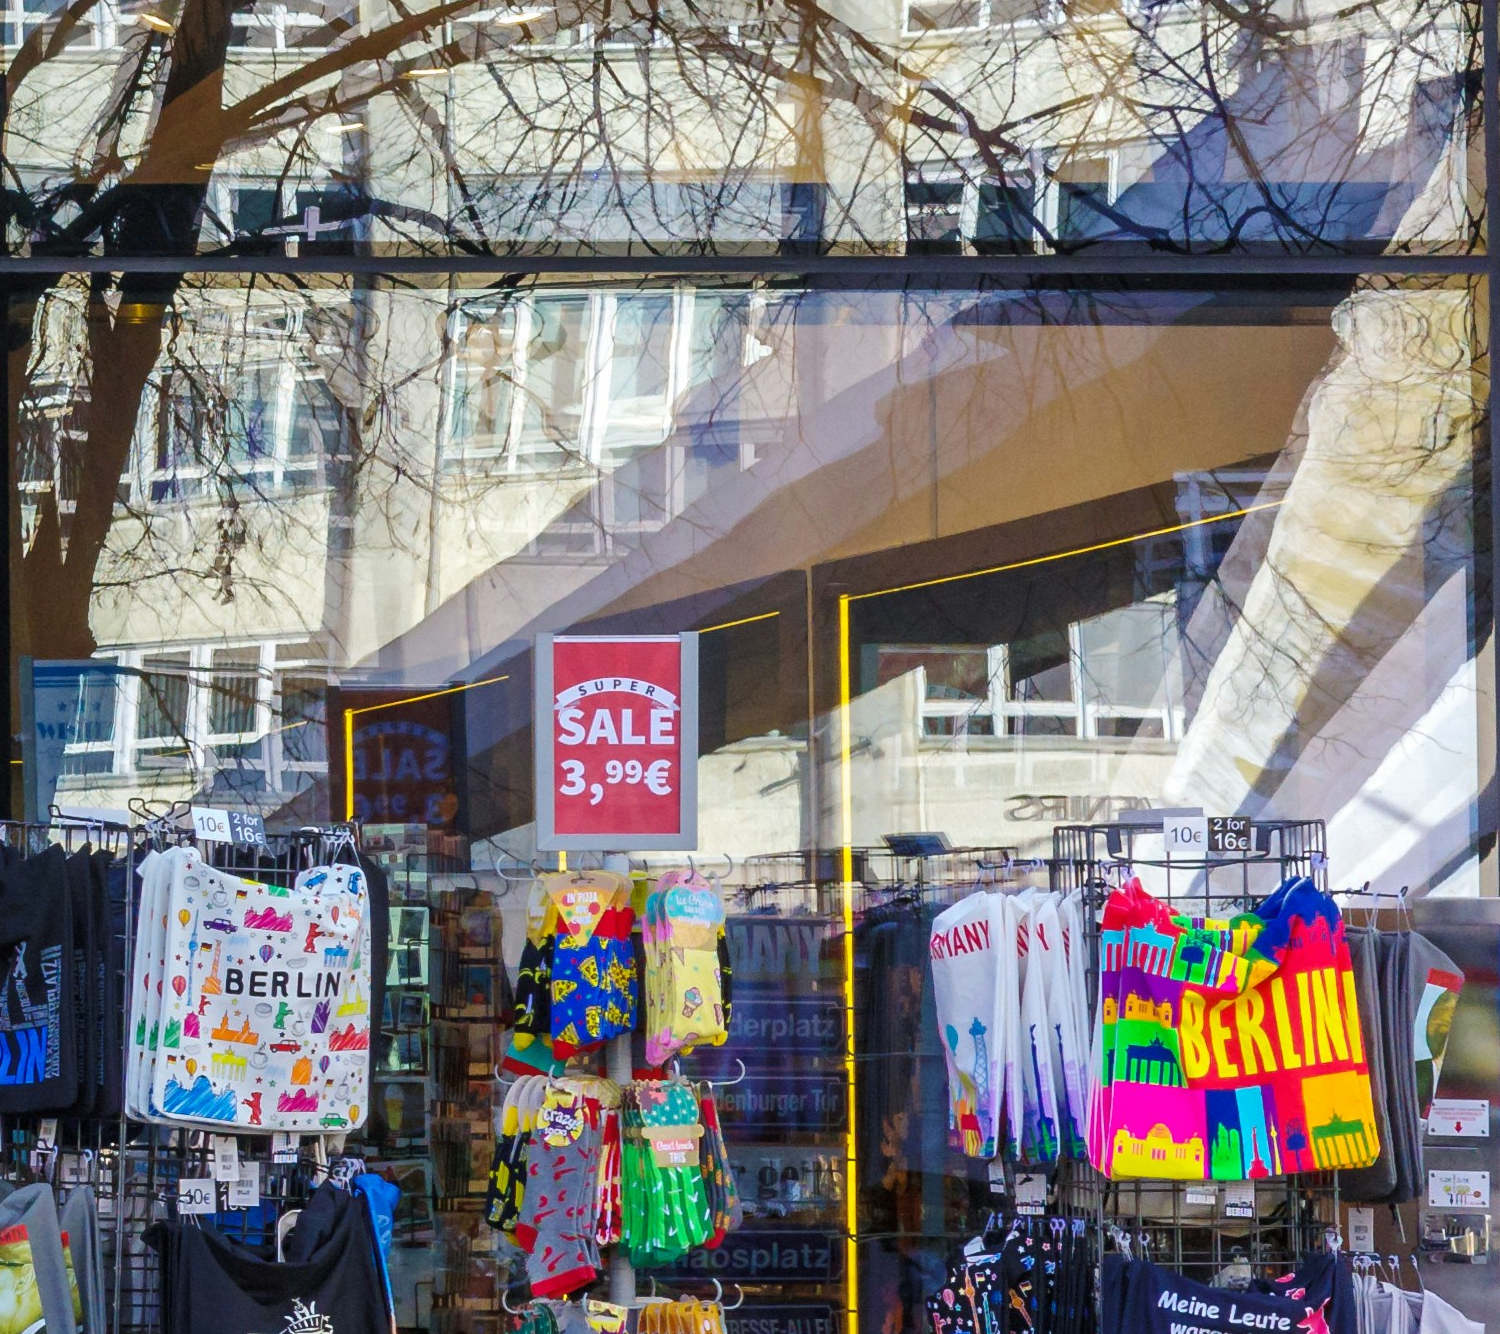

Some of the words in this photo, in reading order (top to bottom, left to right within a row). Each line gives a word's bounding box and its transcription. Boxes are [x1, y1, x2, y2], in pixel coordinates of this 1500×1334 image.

[578, 679, 655, 696] SUPER
[558, 709, 675, 745] SALE
[559, 759, 672, 806] 3,99€
[198, 816, 225, 833] 10€
[232, 813, 239, 822] 2
[243, 814, 258, 826] for
[1213, 818, 1222, 831] 2
[1225, 818, 1246, 831] for
[235, 827, 264, 843] 16€
[1169, 826, 1202, 844] 10€
[1213, 833, 1249, 851] 16€
[579, 892, 598, 903] PIZZA
[225, 968, 341, 998] BERLIN
[1179, 967, 1350, 1080] BERLIN
[669, 1152, 686, 1163] THIS
[1157, 1290, 1221, 1319] Meine
[1228, 1304, 1291, 1331] Leute
